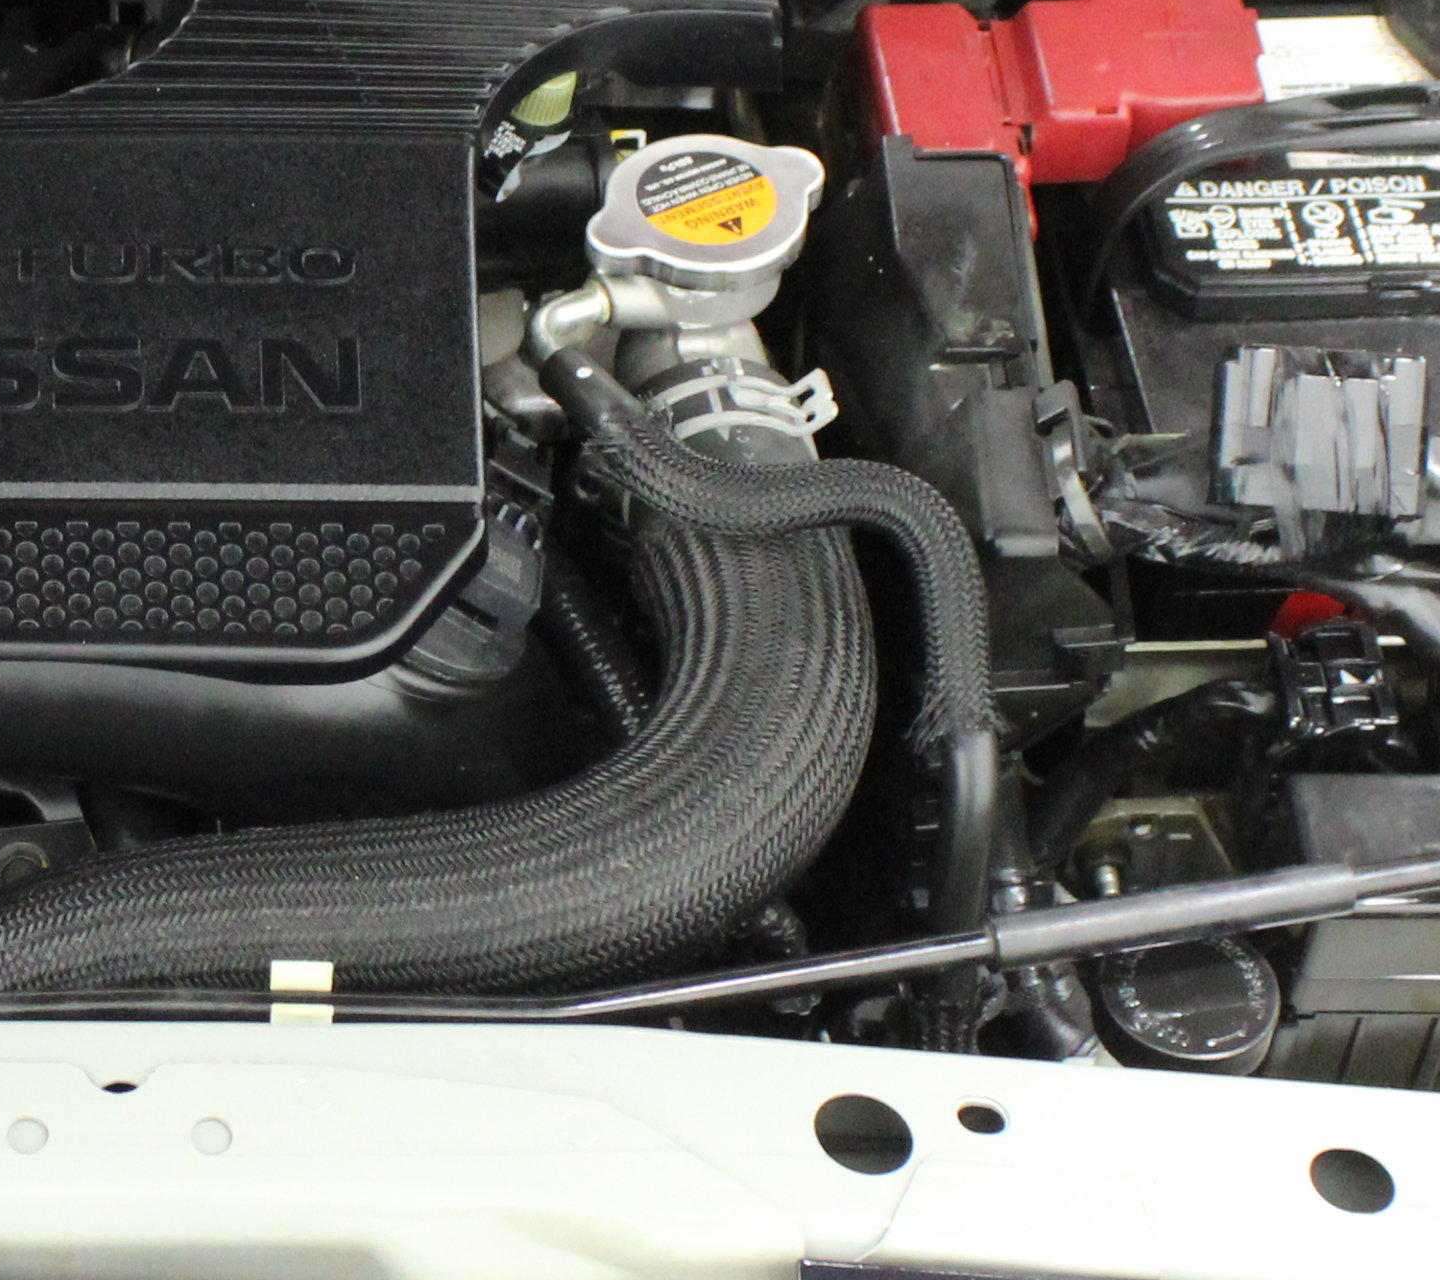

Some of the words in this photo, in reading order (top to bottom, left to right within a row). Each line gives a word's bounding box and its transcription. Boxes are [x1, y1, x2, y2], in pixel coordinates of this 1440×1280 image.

[660, 180, 765, 224] AVERTISSEMENT
[1200, 180, 1305, 197] DANGER
[1310, 179, 1324, 196] /
[1330, 176, 1426, 194] POISON
[685, 197, 760, 229] WARNING
